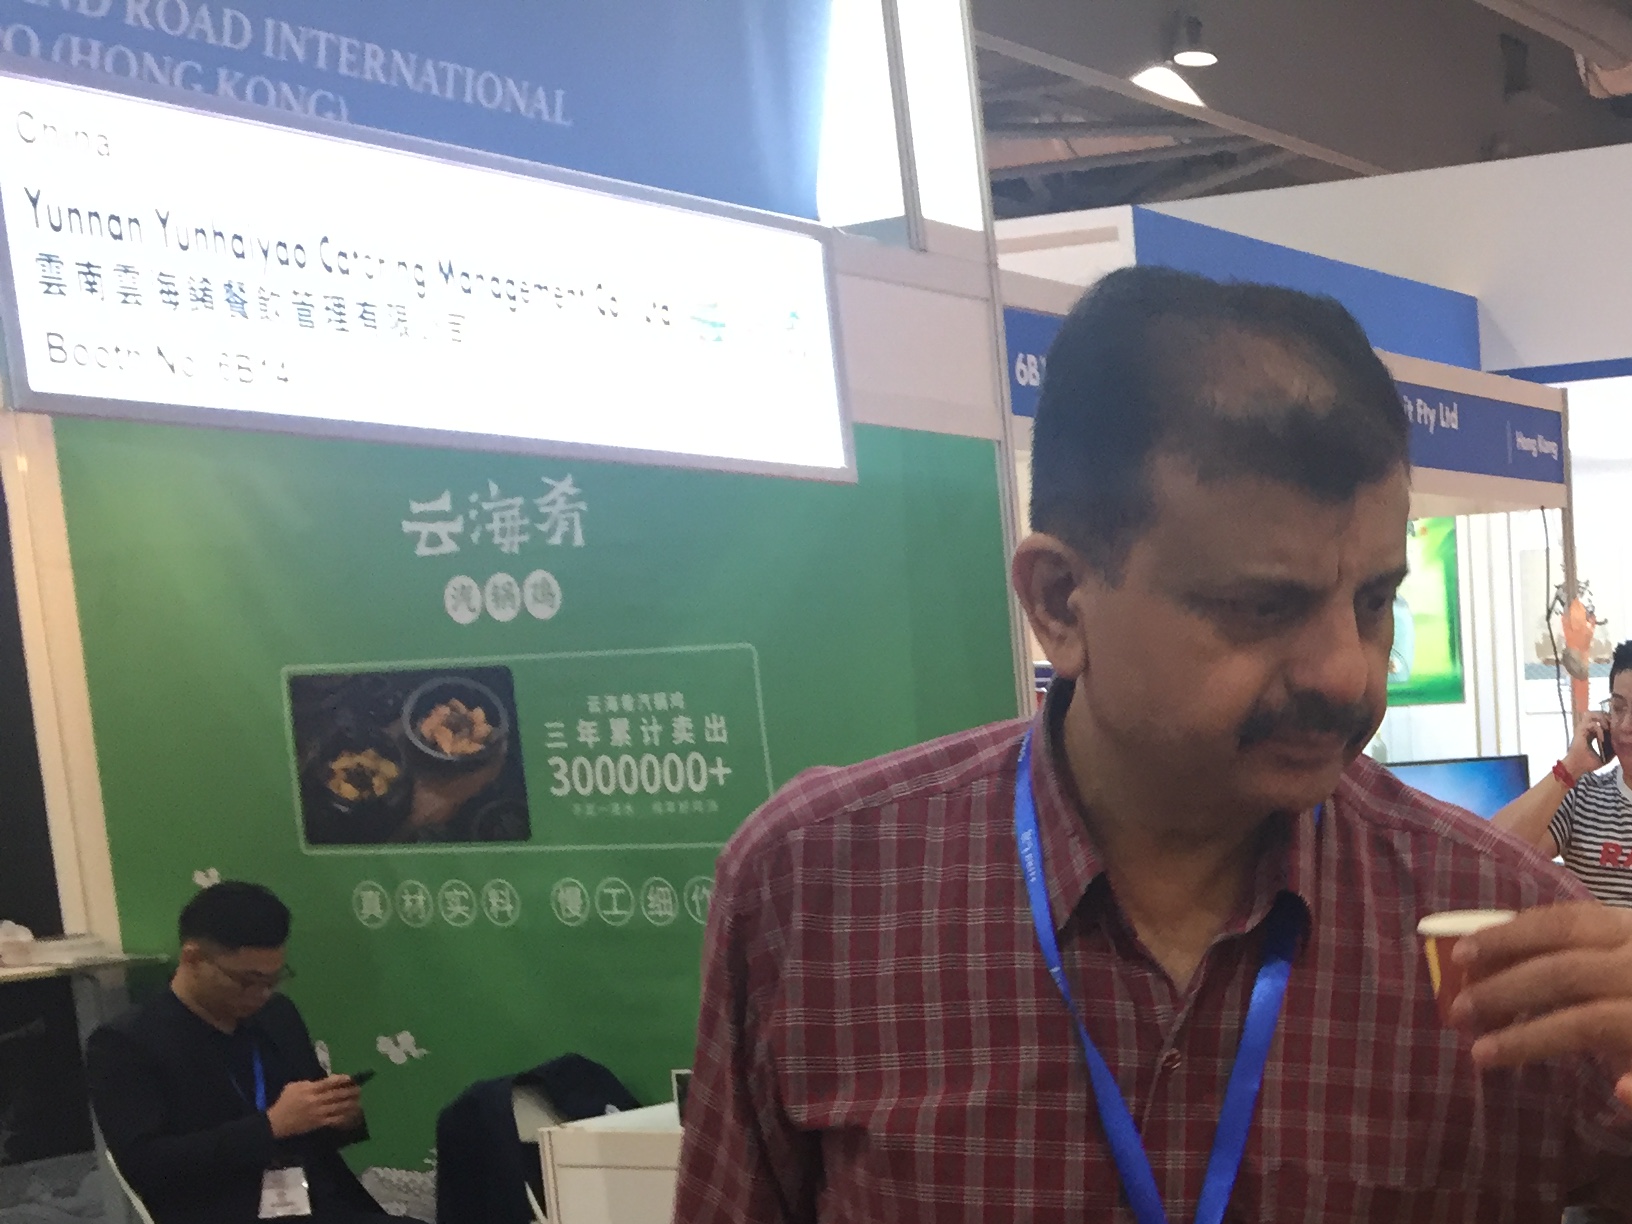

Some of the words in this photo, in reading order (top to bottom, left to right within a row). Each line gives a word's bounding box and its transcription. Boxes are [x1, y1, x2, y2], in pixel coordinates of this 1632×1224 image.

[123, 0, 252, 50] ROAD
[262, 17, 573, 126] INTERNATIONAL
[16, 110, 110, 157] Chna
[24, 187, 143, 243] Yunnan
[320, 235, 425, 298] Caerng
[401, 473, 588, 557] 云海肴
[547, 751, 732, 796] 3000000+
